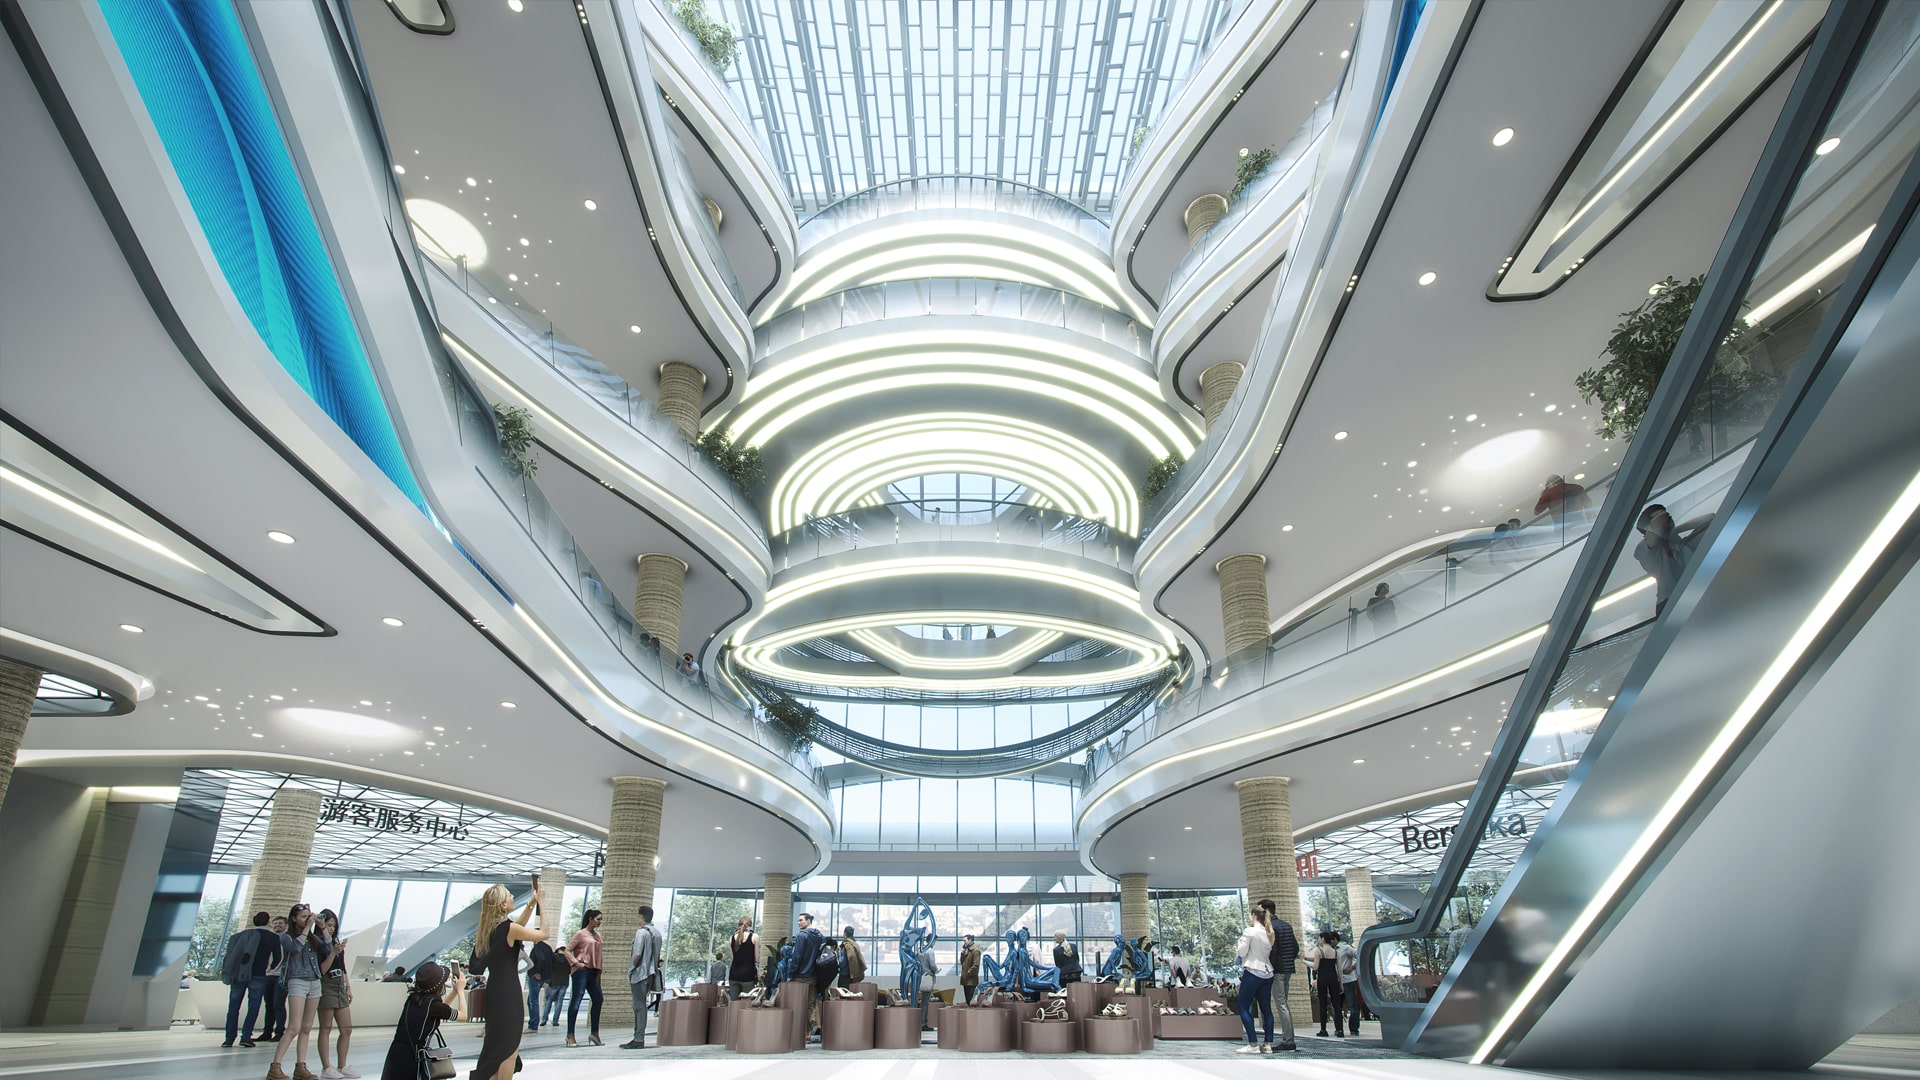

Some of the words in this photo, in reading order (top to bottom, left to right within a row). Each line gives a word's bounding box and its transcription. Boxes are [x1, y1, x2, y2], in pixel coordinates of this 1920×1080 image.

[320, 797, 469, 841] 游客服务中心
